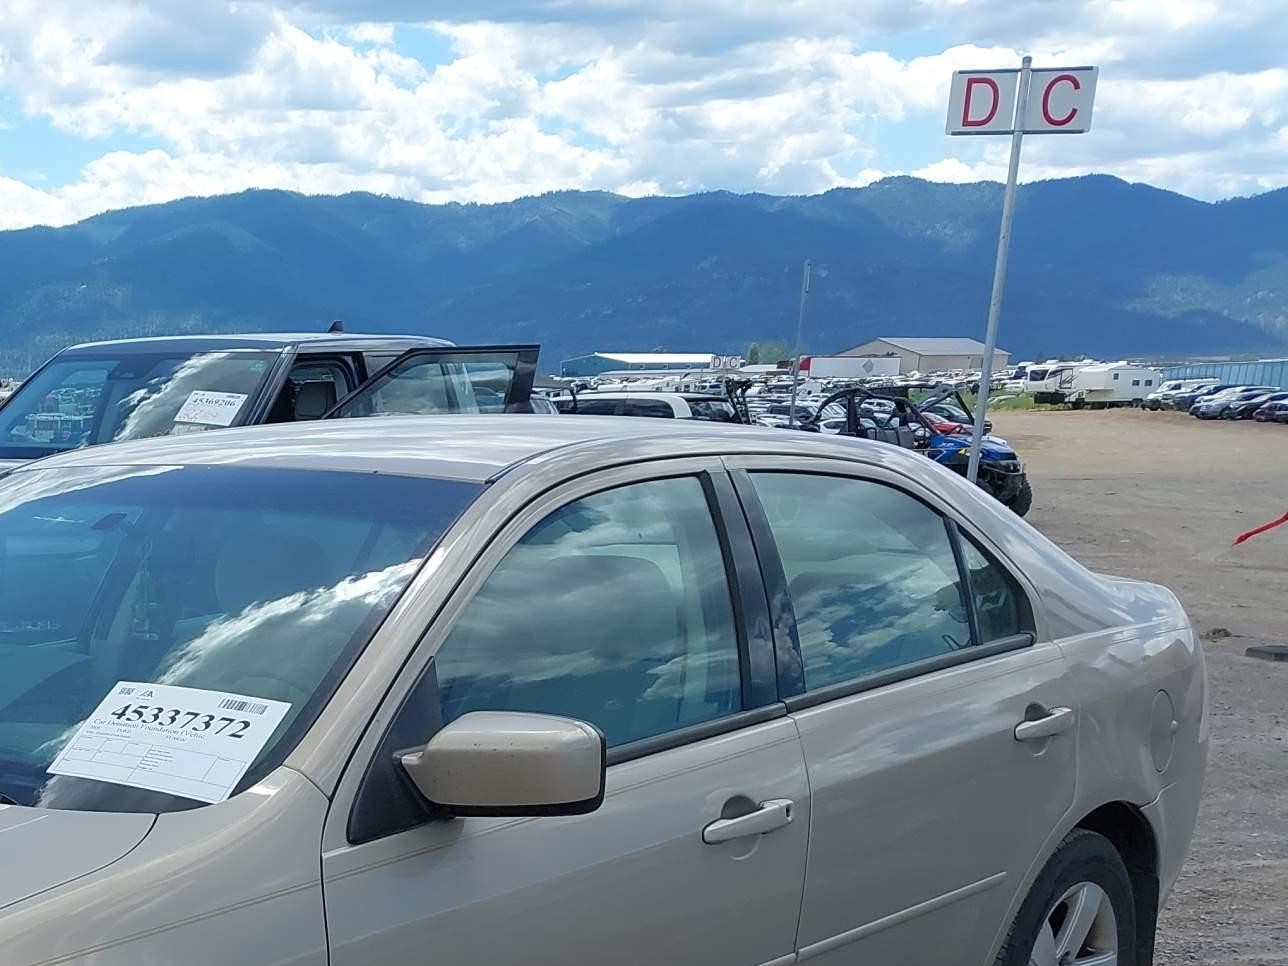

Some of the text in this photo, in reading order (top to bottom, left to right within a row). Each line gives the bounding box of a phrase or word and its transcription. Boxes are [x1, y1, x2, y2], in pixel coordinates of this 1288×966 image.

[962, 74, 1081, 127] D C
[713, 356, 738, 368] D C
[111, 703, 252, 739] 45337372
